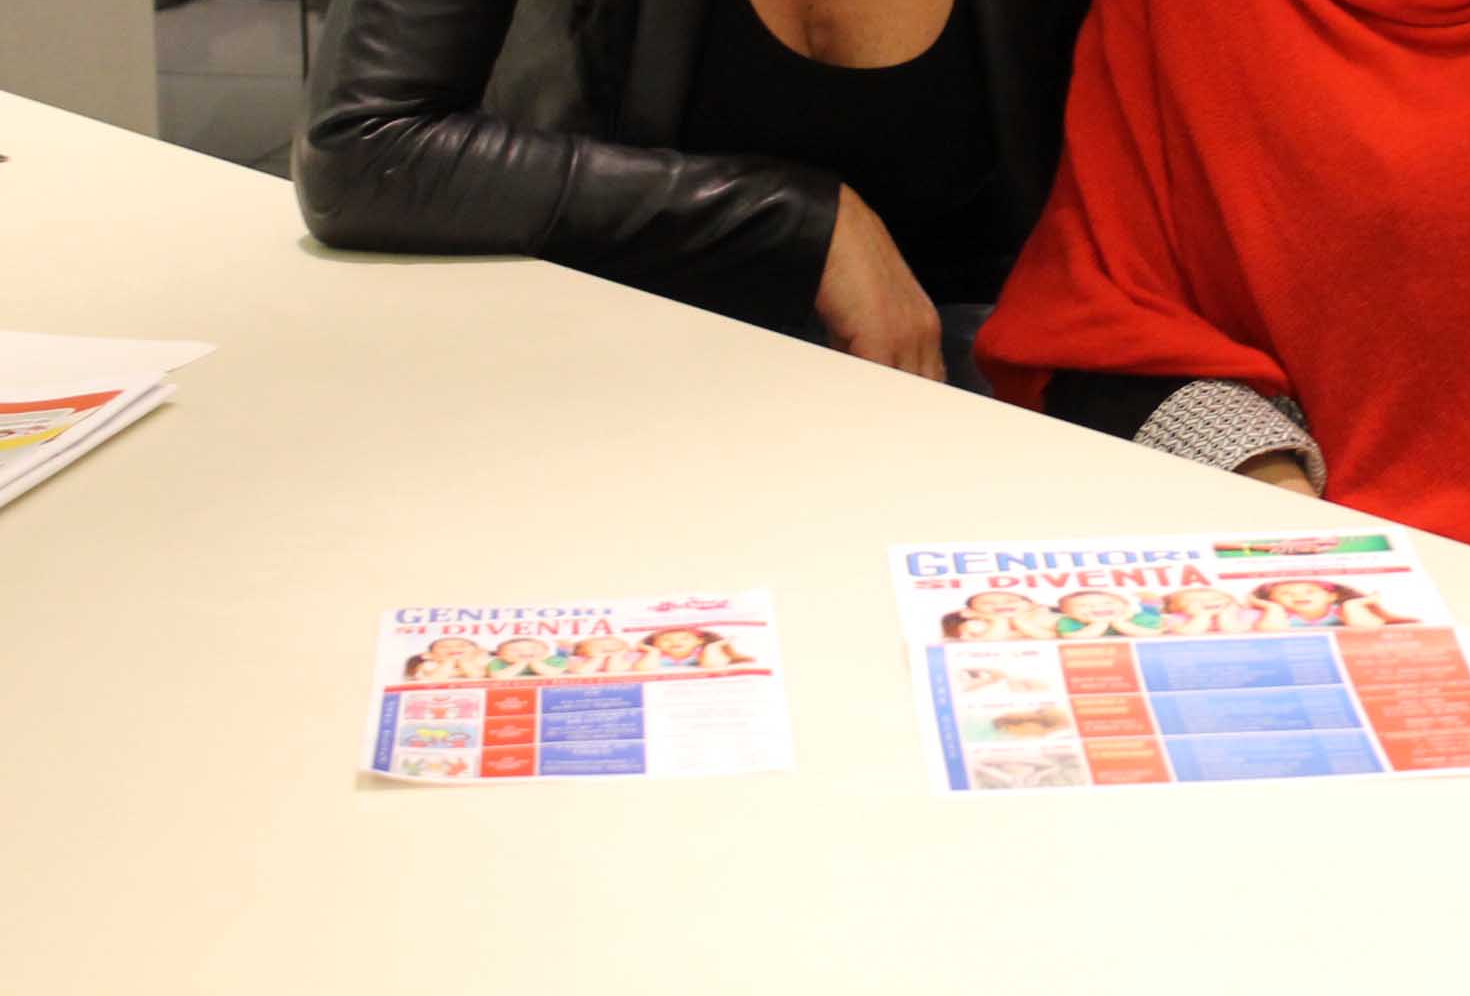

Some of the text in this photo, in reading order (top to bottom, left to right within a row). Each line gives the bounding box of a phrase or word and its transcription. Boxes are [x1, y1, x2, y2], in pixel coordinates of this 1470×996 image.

[904, 550, 1202, 578] GENITORI
[987, 565, 1214, 589] DIVENTA
[394, 606, 613, 624] GENITORI
[439, 617, 615, 636] DIVENTA
